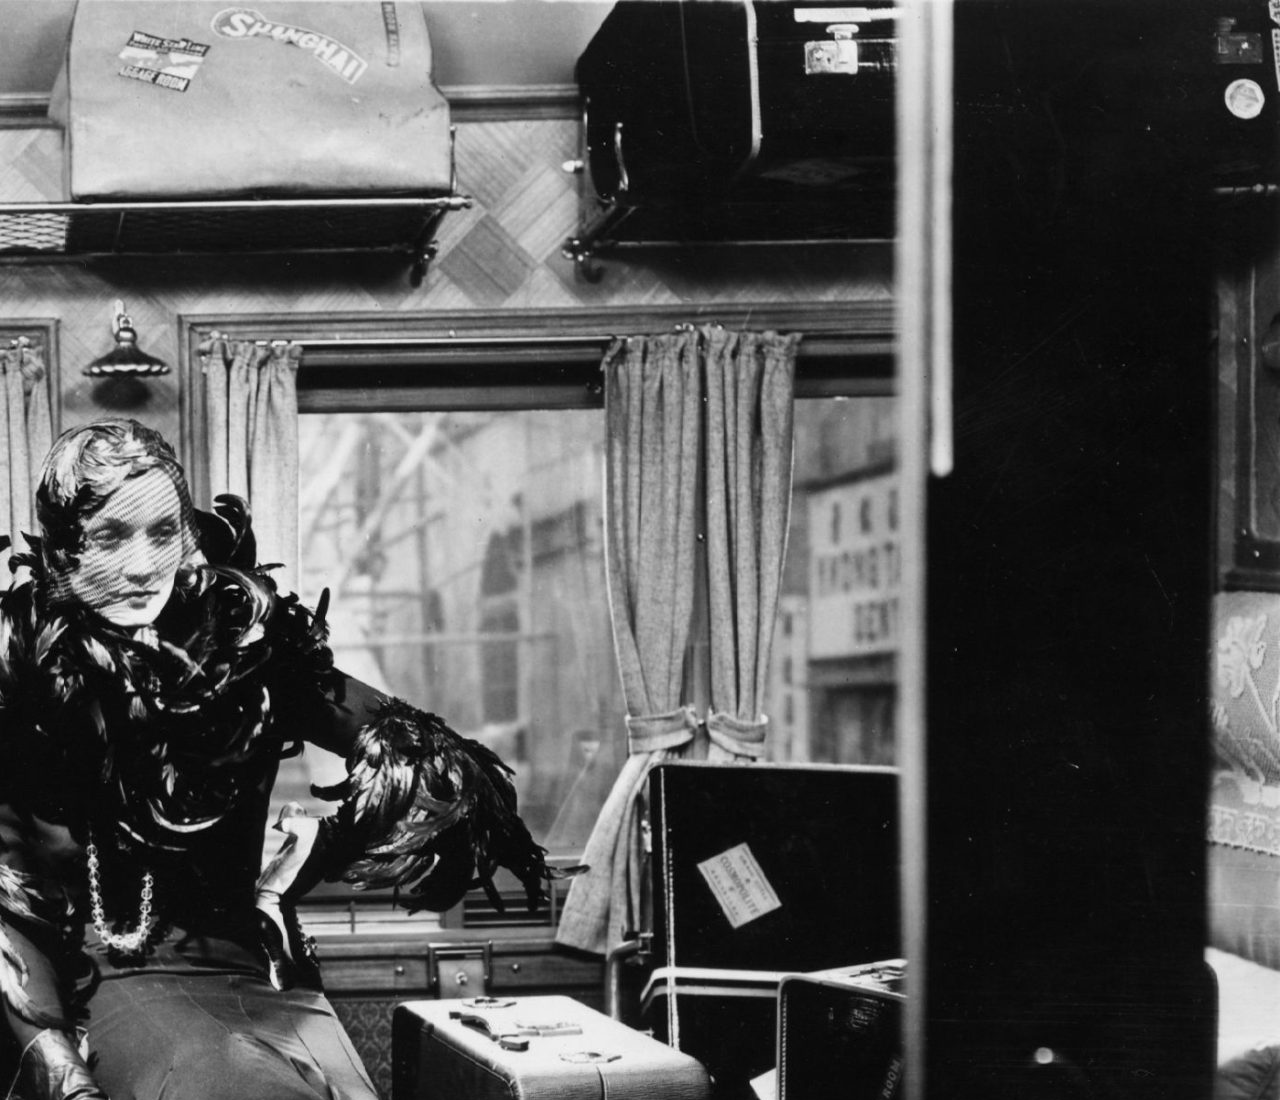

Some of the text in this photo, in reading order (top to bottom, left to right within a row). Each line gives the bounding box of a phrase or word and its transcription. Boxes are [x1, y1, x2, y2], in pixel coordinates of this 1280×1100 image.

[222, 13, 359, 78] SHANGHAI
[154, 73, 189, 91] ROOM
[720, 855, 761, 915] COSMOPOLITE
[882, 1058, 902, 1099] ROOM
